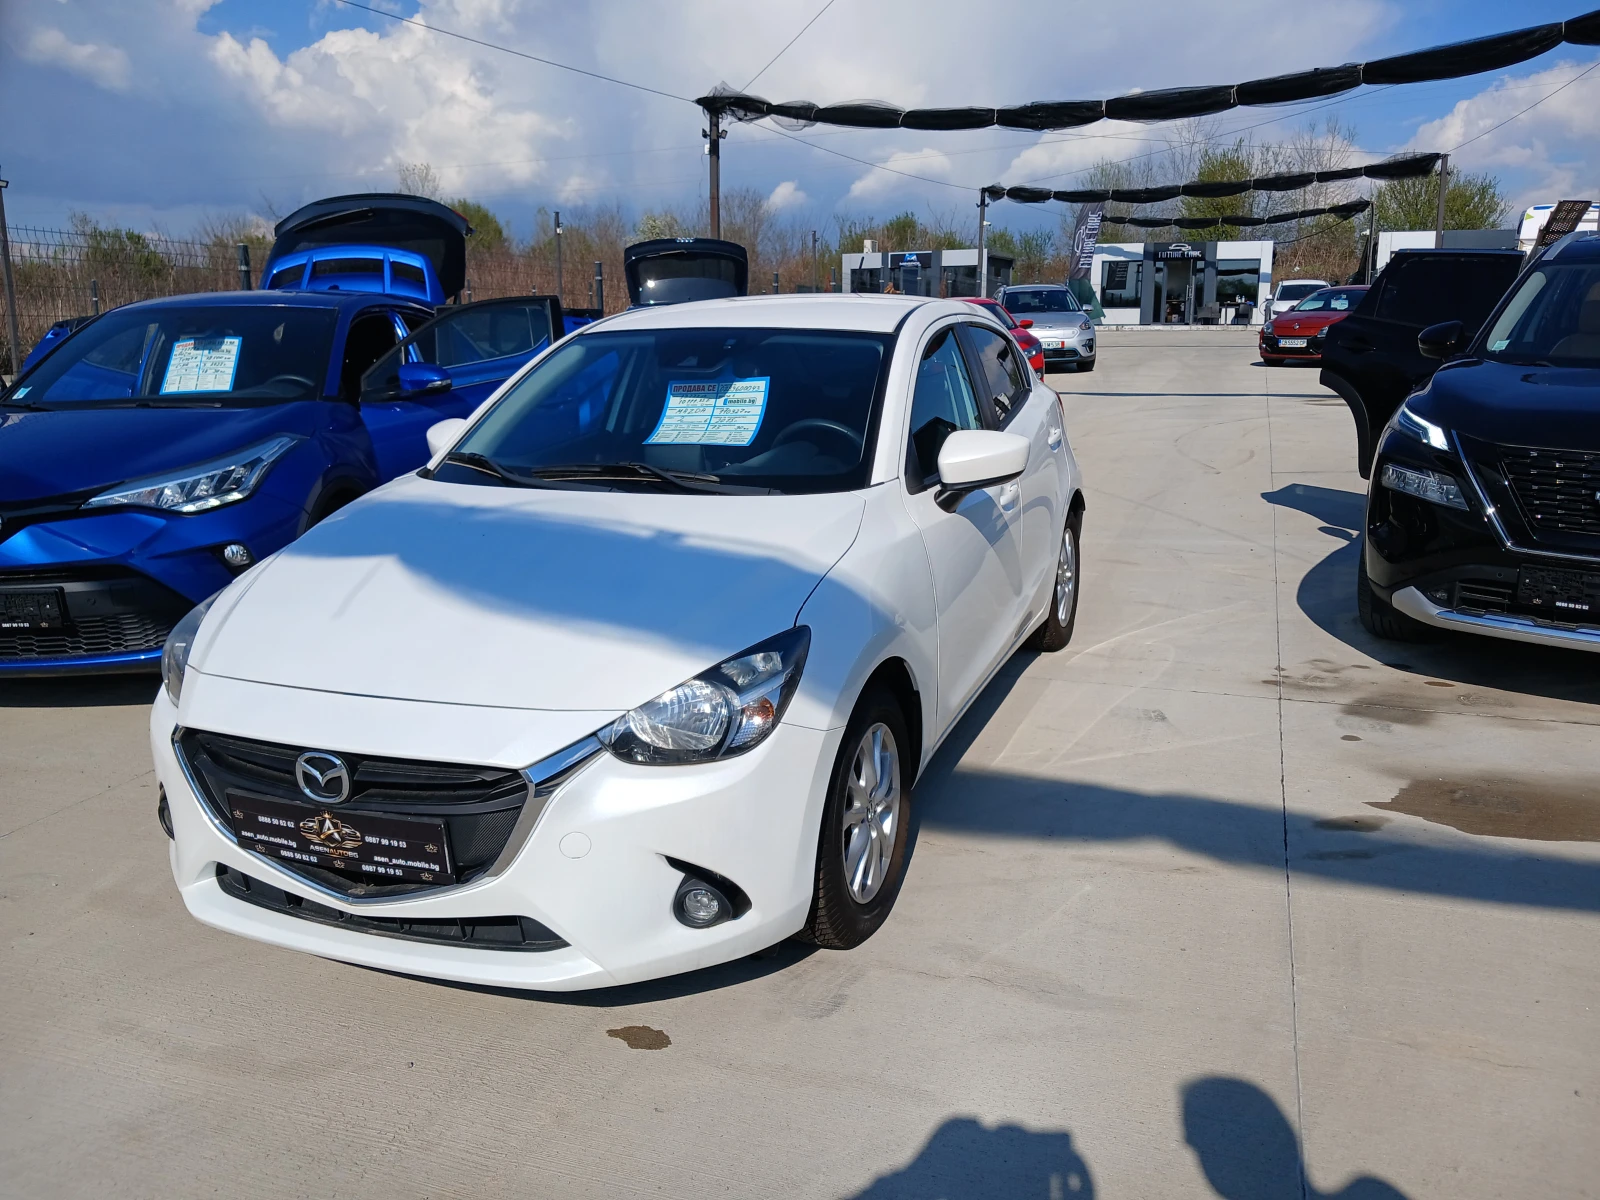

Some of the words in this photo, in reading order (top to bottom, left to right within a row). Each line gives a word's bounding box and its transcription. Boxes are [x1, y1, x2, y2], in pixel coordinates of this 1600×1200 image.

[1086, 211, 1103, 233] CARS
[1079, 236, 1097, 268] FUTURE
[1158, 251, 1183, 259] FUTURE
[1184, 250, 1202, 258] CARS
[707, 384, 717, 392] СЕ
[365, 835, 380, 844] 0887
[380, 838, 389, 846] 99
[390, 839, 398, 847] 19
[373, 855, 440, 872] asen_auto.mobile.bg
